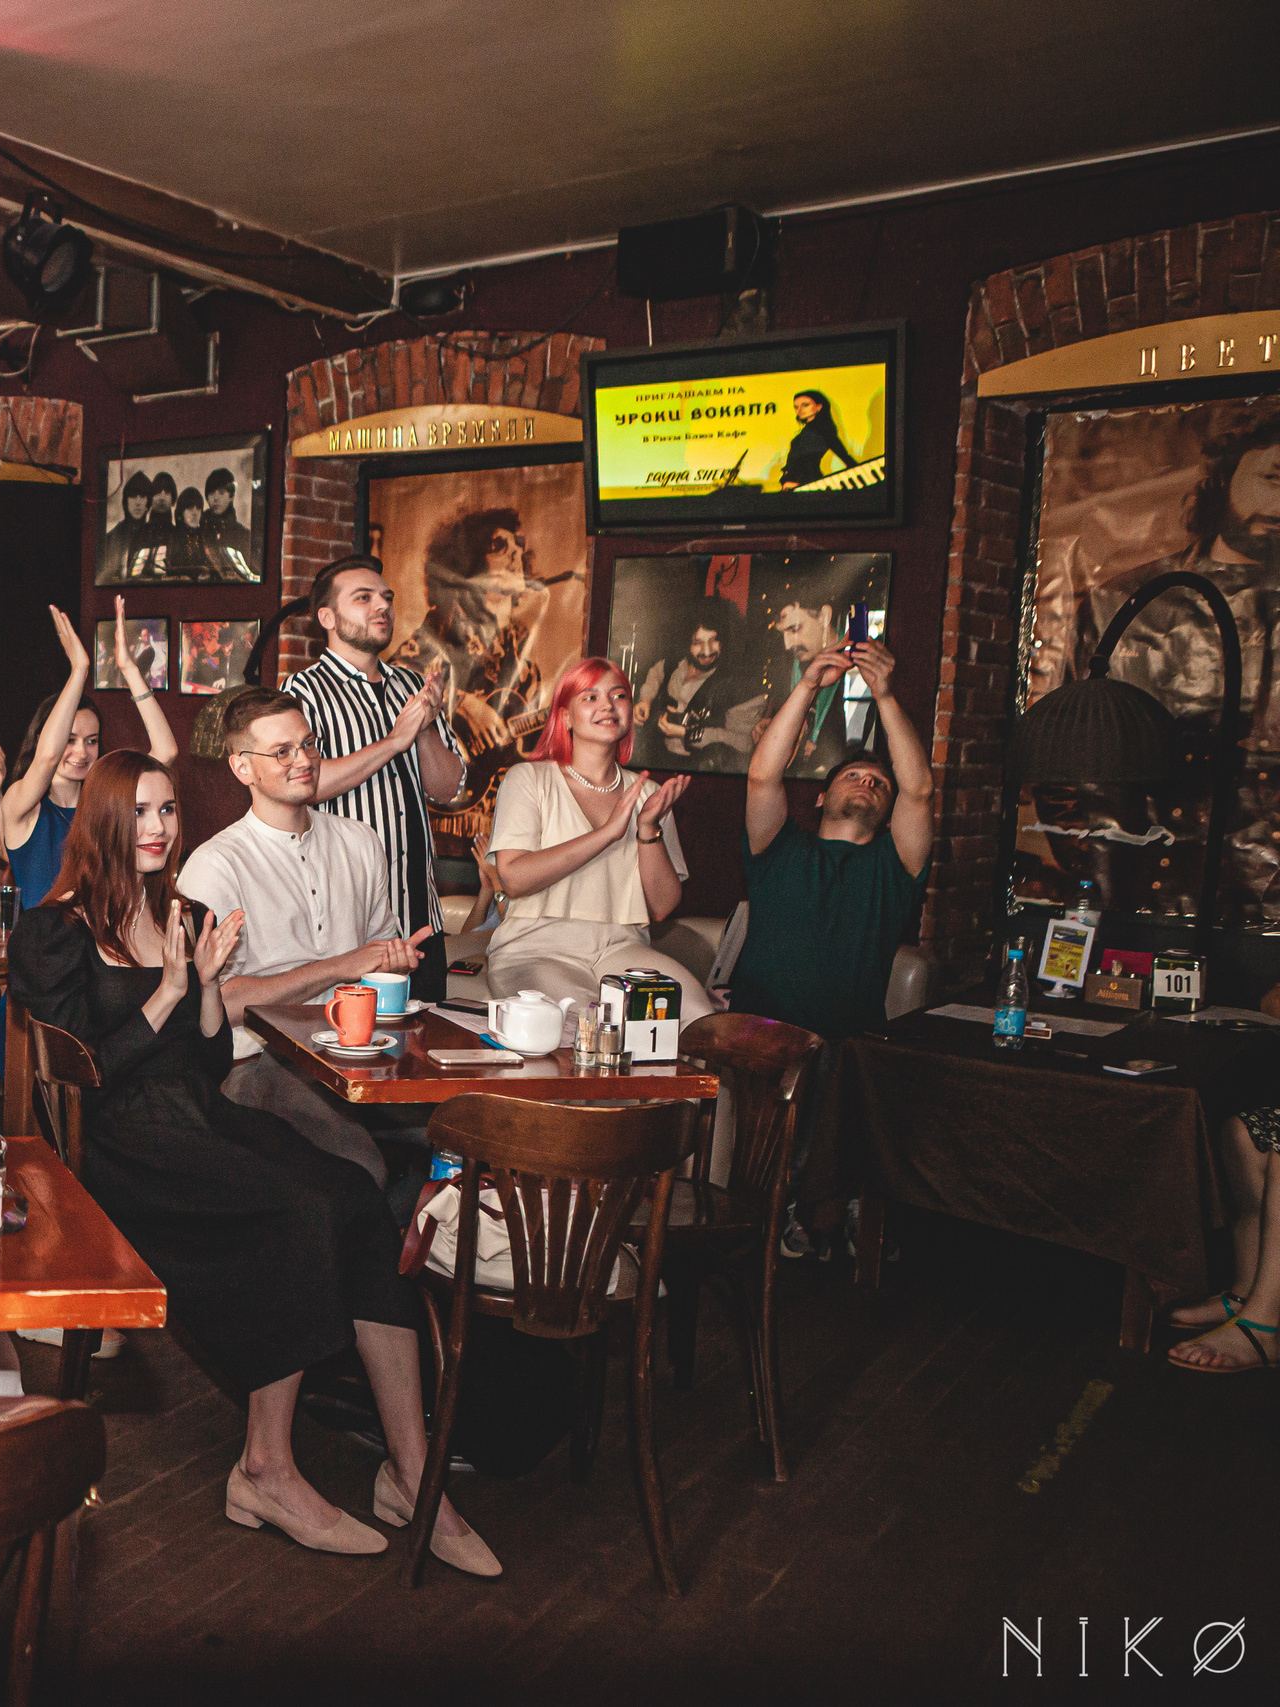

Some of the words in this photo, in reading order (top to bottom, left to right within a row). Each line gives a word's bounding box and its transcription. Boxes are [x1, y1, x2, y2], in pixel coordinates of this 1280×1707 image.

[1138, 333, 1277, 379] ЦВЕТ
[635, 388, 723, 402] ПРИГЛАШАЕМ
[728, 386, 745, 395] НА
[615, 410, 681, 426] УРОКИ
[329, 424, 418, 451] МАШИНА
[717, 429, 747, 439] Кафе
[1165, 974, 1190, 993] 101
[649, 1026, 657, 1053] 1
